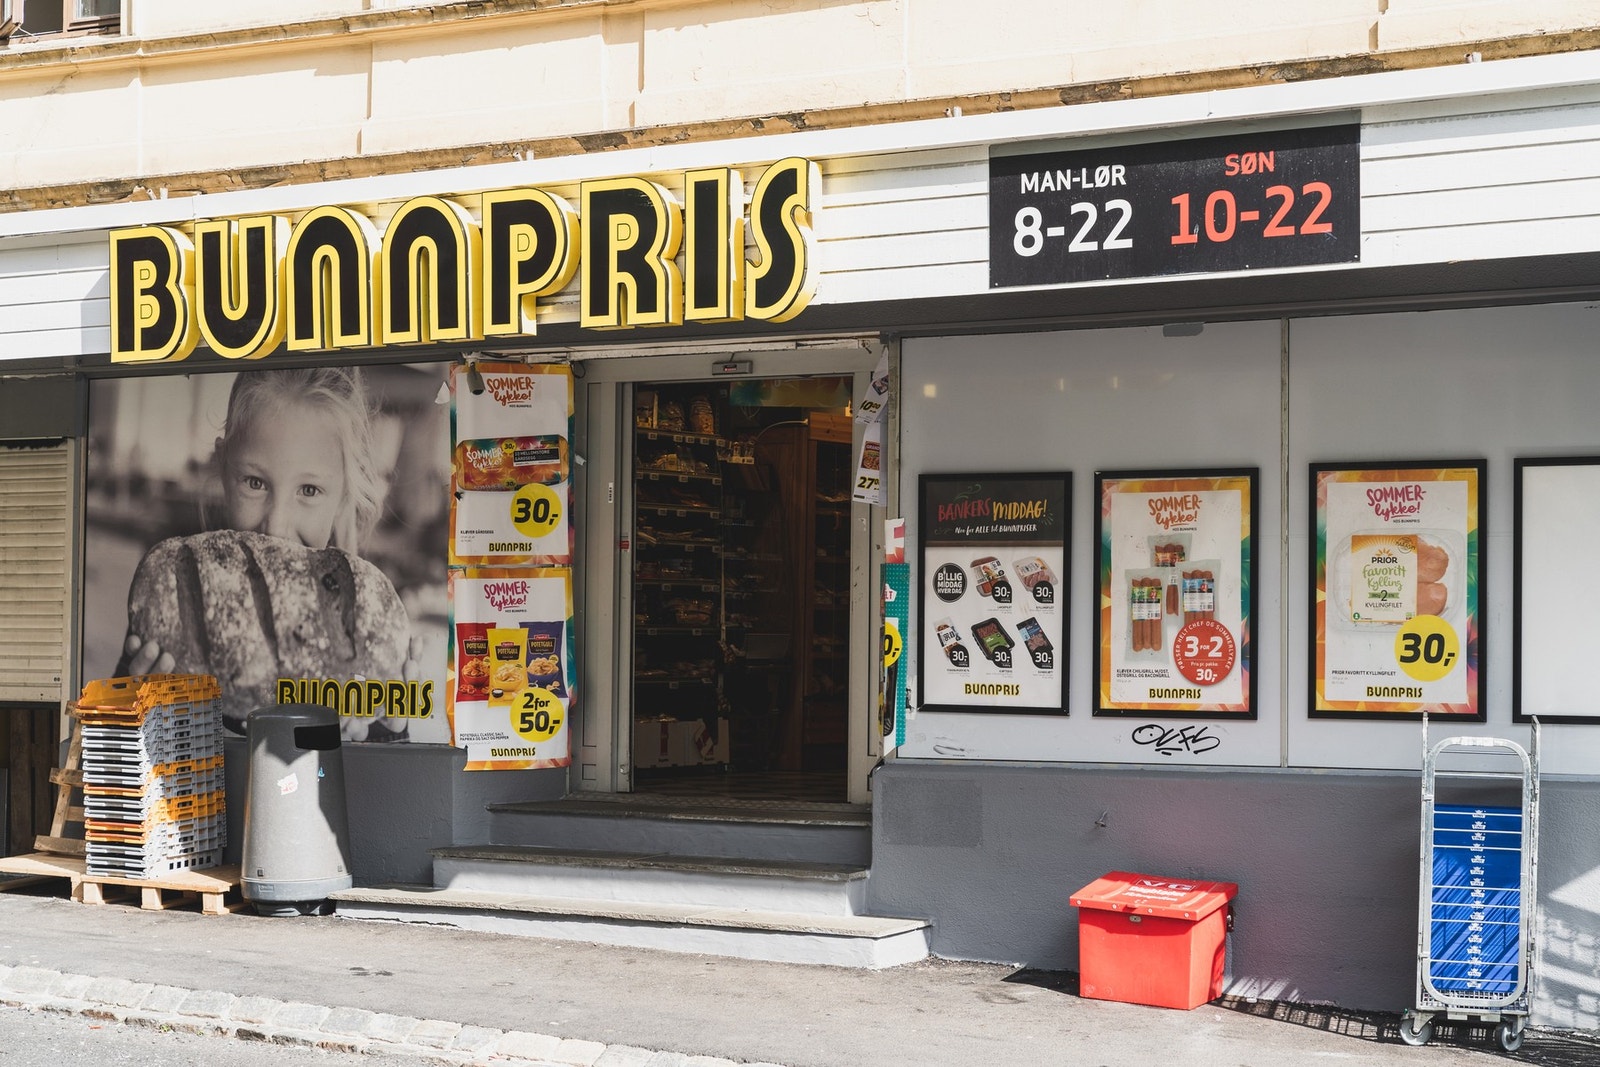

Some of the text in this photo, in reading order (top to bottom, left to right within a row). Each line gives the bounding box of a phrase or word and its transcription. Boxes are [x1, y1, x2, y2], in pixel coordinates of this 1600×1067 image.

[1225, 151, 1275, 177] SØN
[1020, 164, 1127, 194] MAN-LØR
[1170, 181, 1333, 246] 10-22
[1013, 198, 1133, 257] 8-22
[109, 156, 821, 363] BUNNPRIS
[486, 376, 536, 394] SOMMER-
[494, 389, 531, 407] lykke!
[1366, 484, 1427, 506] SOMMER-
[514, 498, 559, 525] 30,-
[938, 498, 1047, 522] BANKERS MIDDAG!
[1148, 494, 1203, 516] SOMMER-
[1374, 501, 1421, 521] lykke!
[1156, 510, 1198, 530] lykke!
[975, 525, 989, 534] ALLE
[489, 542, 532, 552] BUNNPRIS
[1371, 556, 1398, 564] PRIOR
[937, 571, 963, 581] BILLIG
[484, 580, 531, 599] SOMMER-
[994, 586, 1011, 597] 30,-
[1035, 587, 1052, 598] 30,-
[490, 594, 527, 612] lykke!
[952, 650, 968, 661] 30,-
[1184, 635, 1199, 658] 3
[1207, 635, 1223, 658] 2
[1400, 633, 1455, 666] 30,-
[994, 651, 1011, 662] 30,-
[1035, 652, 1052, 663] 30,-
[1196, 668, 1218, 683] 30,-
[277, 678, 434, 719] BUNNPRIS
[964, 683, 1020, 696] BUNNPRIS
[1149, 688, 1201, 699] BUNNPRIS
[1366, 686, 1423, 698] BUNNPRIS
[519, 711, 560, 735] 50,-
[491, 747, 536, 757] BUNNPRIS
